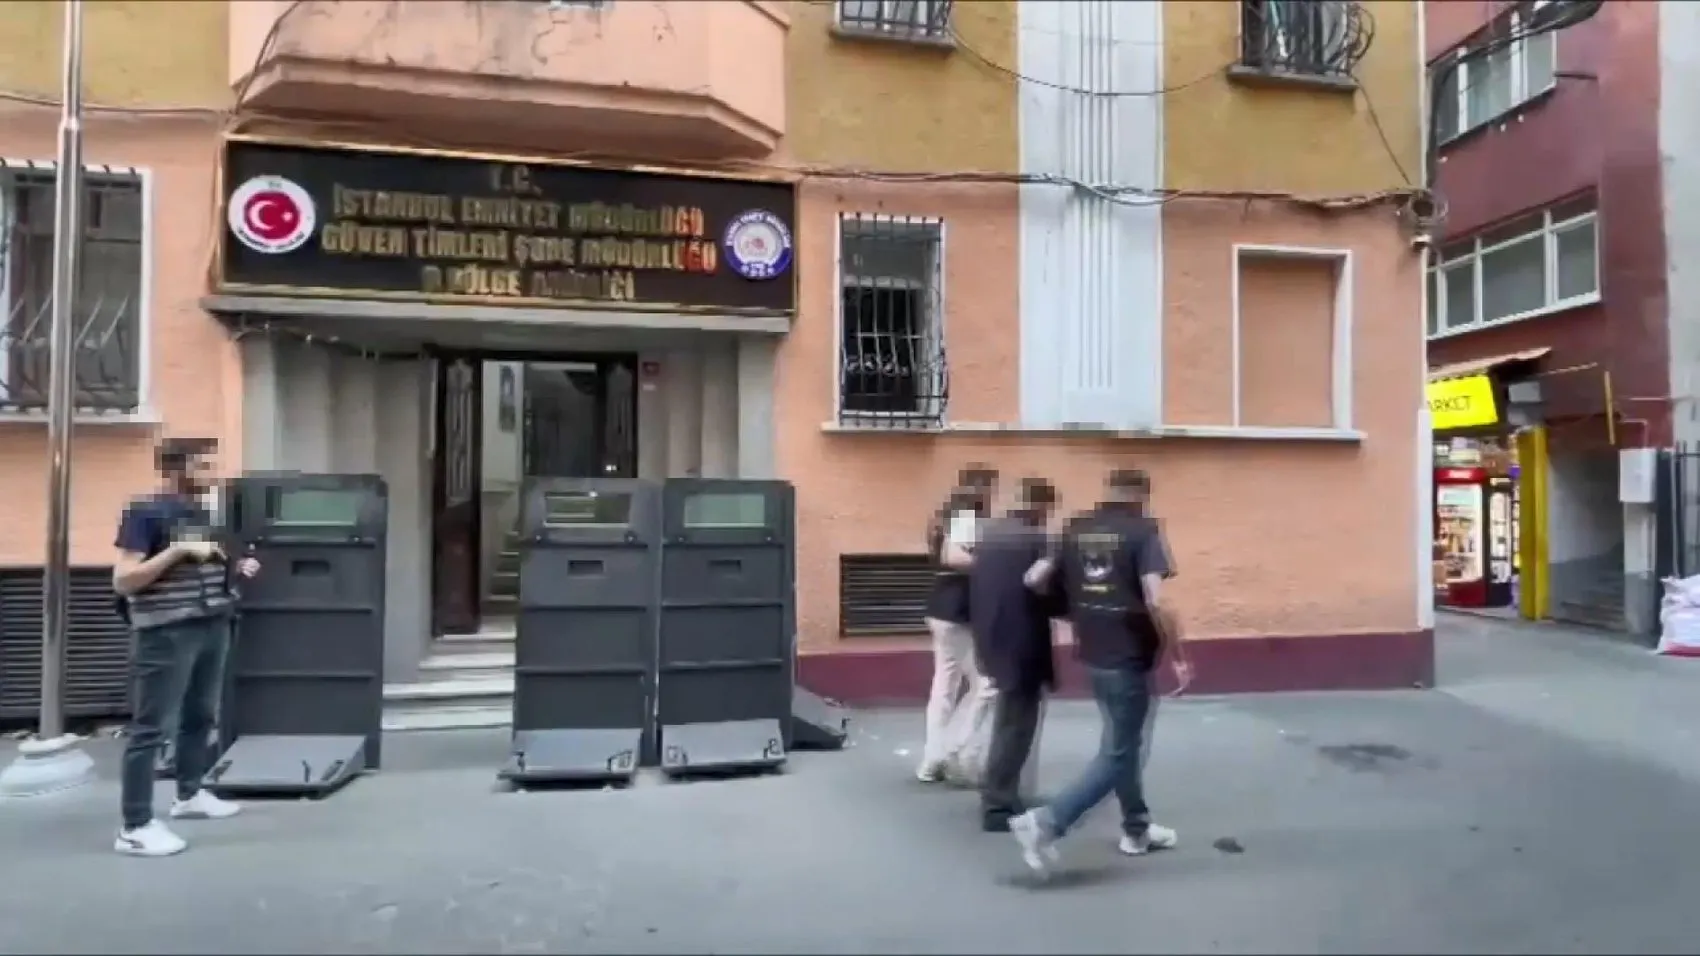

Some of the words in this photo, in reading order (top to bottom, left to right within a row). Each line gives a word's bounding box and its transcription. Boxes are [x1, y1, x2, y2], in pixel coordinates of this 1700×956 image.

[333, 182, 455, 224] İSTANBUL
[461, 196, 561, 230] EMNİYET
[321, 221, 409, 258] GÜVEN
[410, 227, 509, 261] TİMLERİ
